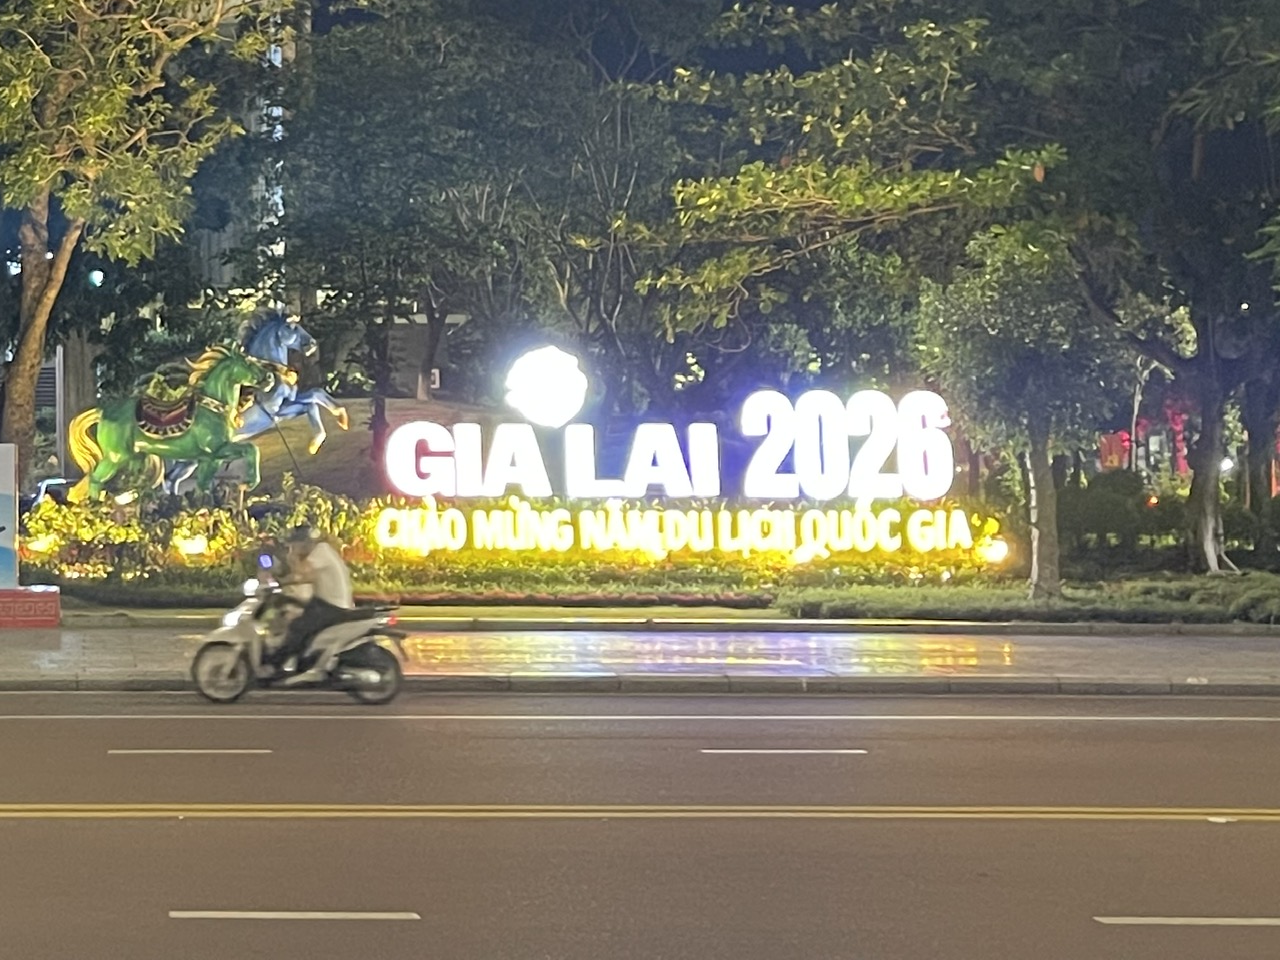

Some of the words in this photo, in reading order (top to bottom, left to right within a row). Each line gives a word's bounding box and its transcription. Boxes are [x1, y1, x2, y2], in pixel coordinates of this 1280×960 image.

[385, 420, 553, 498] GIA
[565, 422, 720, 498] LAI
[742, 390, 954, 501] 2026
[375, 494, 467, 552] CHÀO
[472, 495, 573, 551] MỪNG
[578, 497, 663, 553] NĂM
[667, 509, 713, 552] DU
[800, 495, 902, 559] QUỐC
[907, 509, 973, 551] GIA
